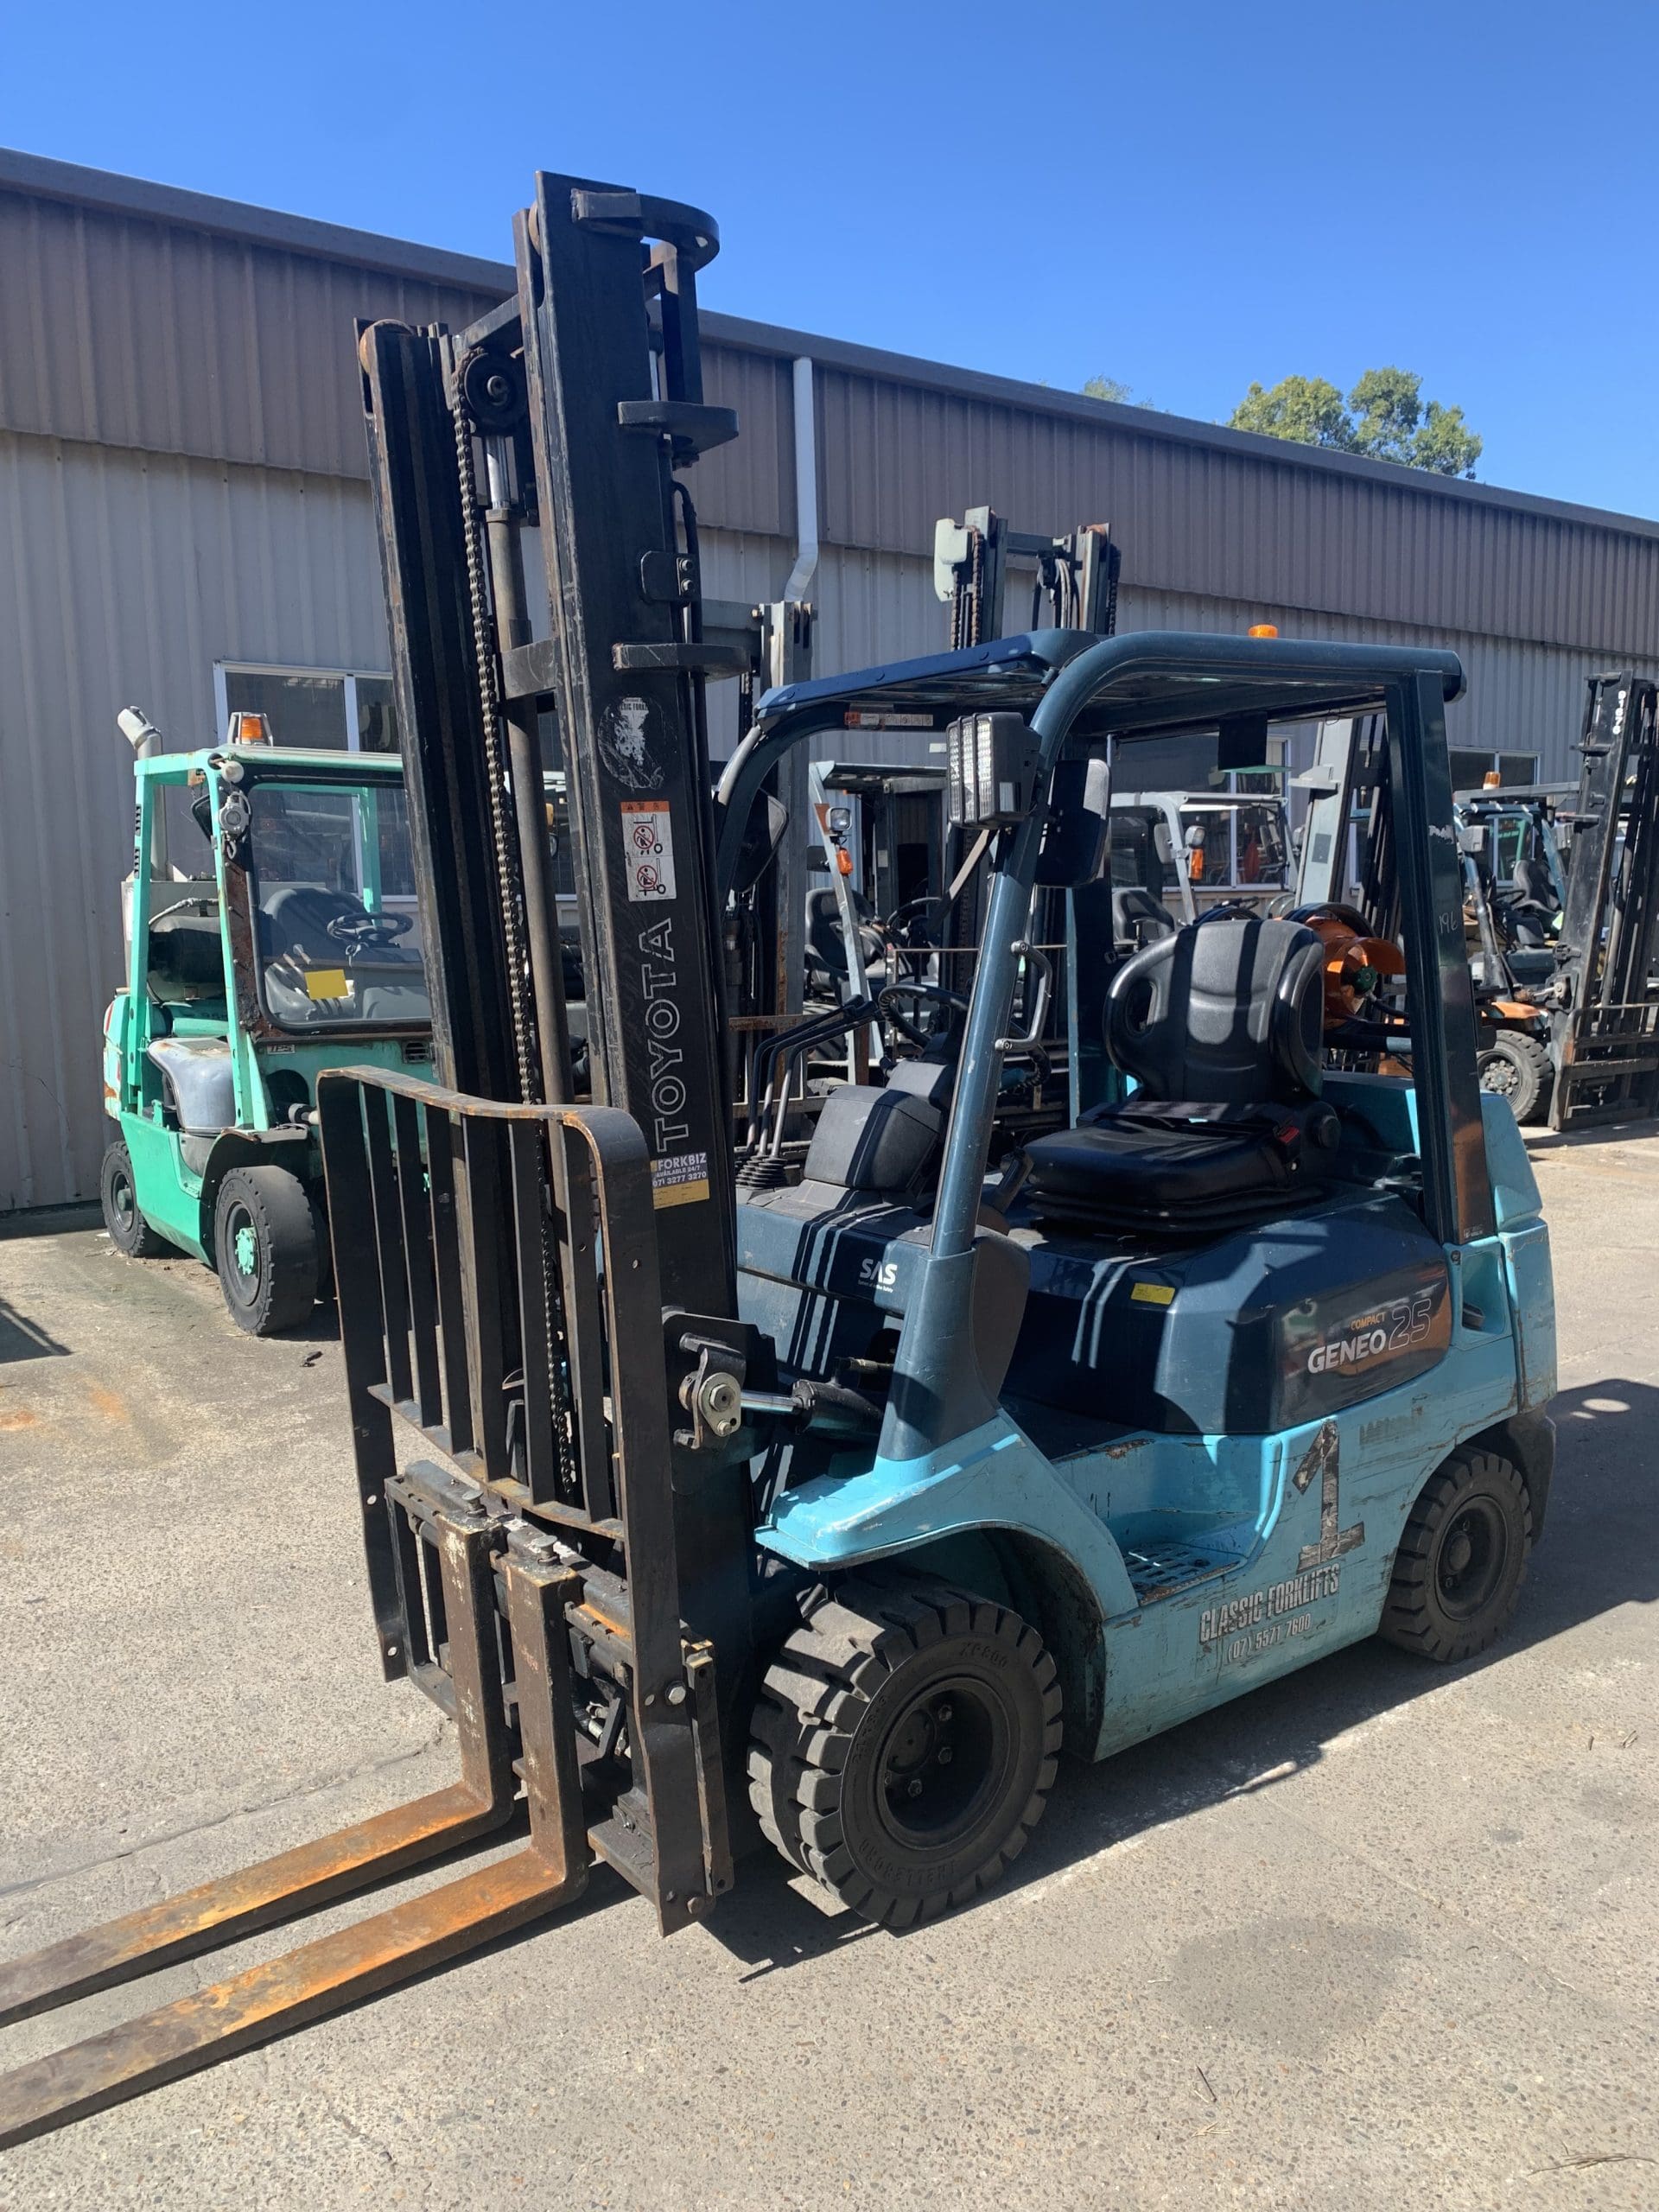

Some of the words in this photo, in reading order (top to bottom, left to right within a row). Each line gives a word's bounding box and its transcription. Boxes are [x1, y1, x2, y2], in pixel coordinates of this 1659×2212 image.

[639, 918, 689, 1153] TOYOTA
[656, 1166, 687, 1178] AVAILABLE
[658, 1152, 707, 1171] FORKBIZ
[666, 1175, 686, 1185] 3277
[688, 1171, 707, 1180] 3270
[859, 1258, 898, 1285] SAS
[1350, 1312, 1387, 1331] COMPACT
[1307, 1329, 1387, 1374] GENEO
[1388, 1298, 1432, 1351] 25
[1199, 1591, 1263, 1643] CLASSIC
[1266, 1562, 1340, 1618] FORKLIFTS
[1228, 1636, 1251, 1662] (07)
[1255, 1624, 1281, 1650] 5571
[1286, 1612, 1312, 1638] 7600
